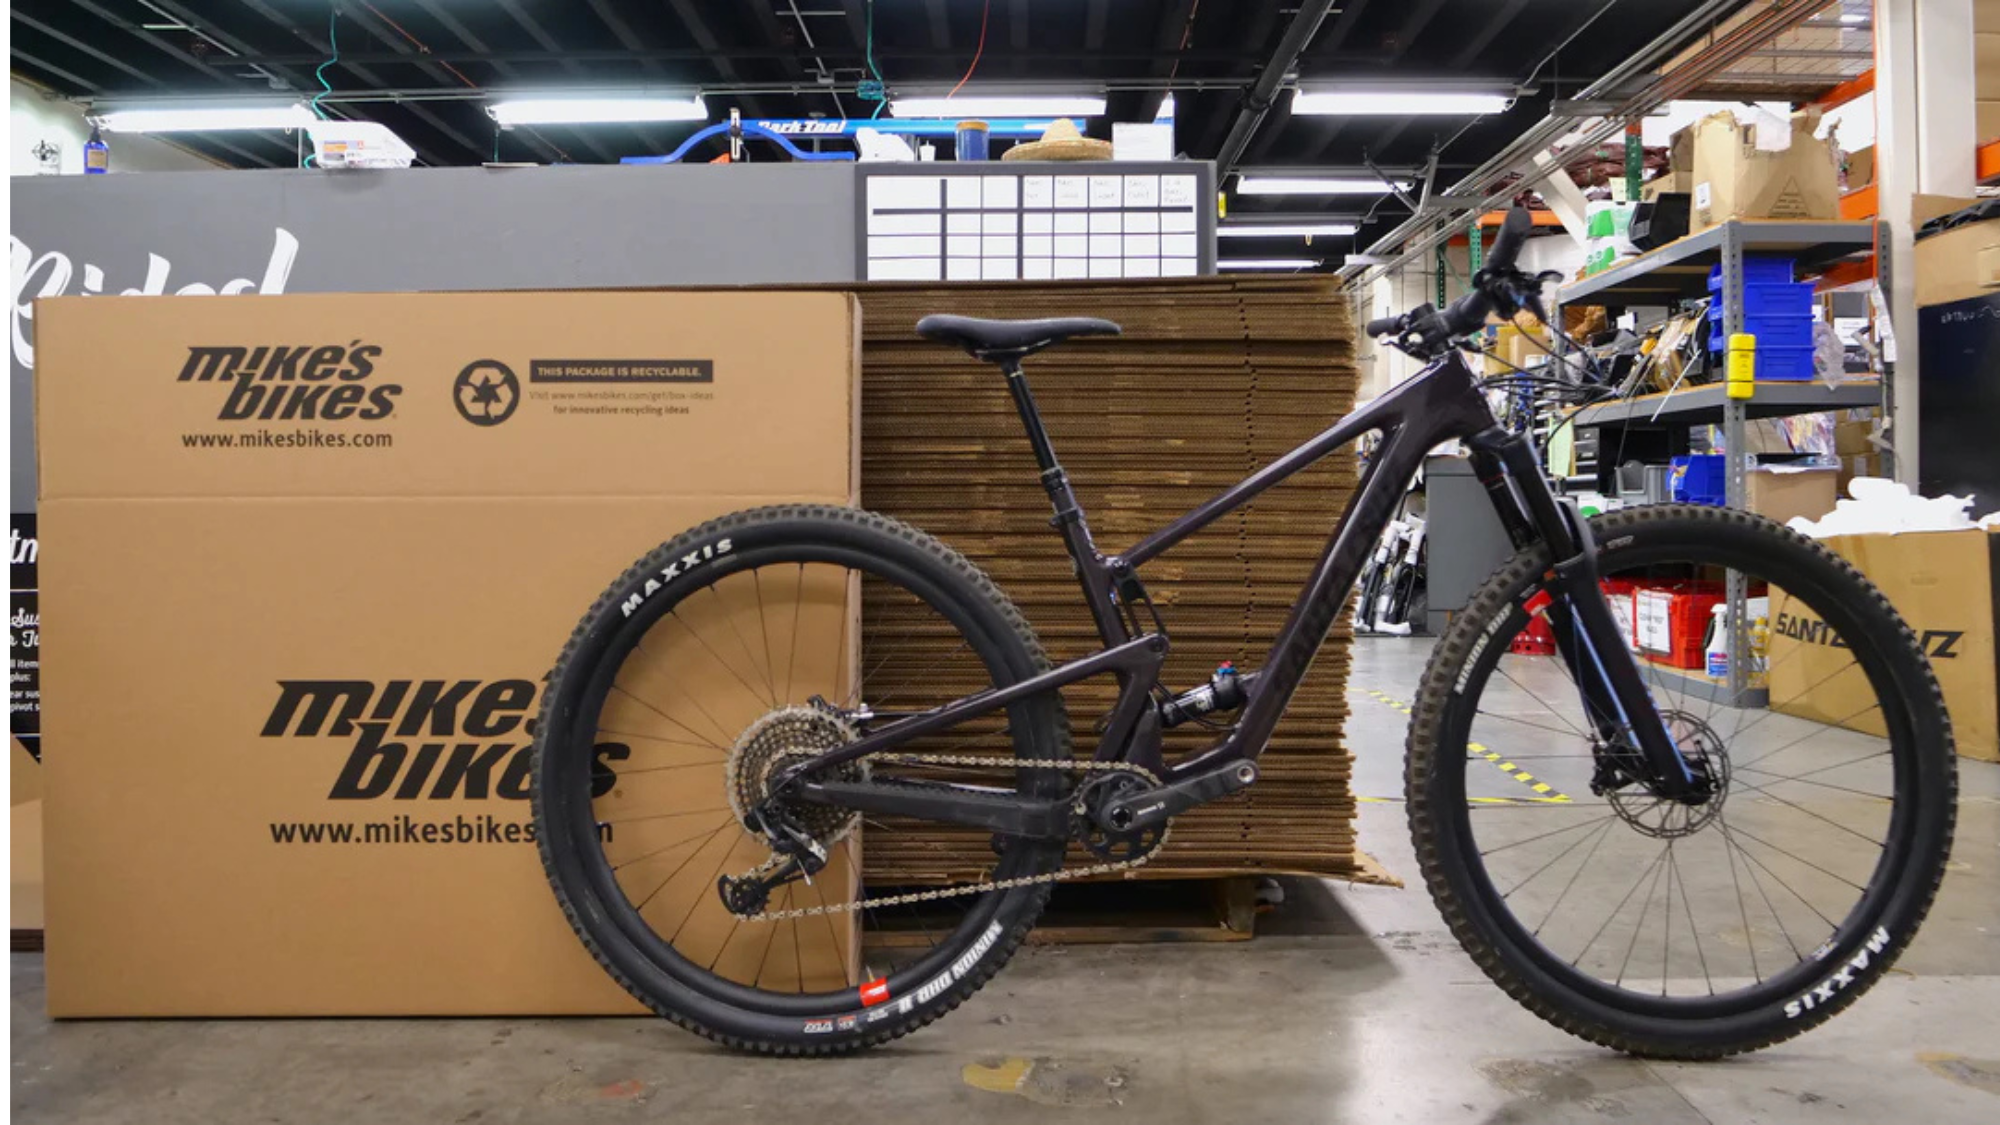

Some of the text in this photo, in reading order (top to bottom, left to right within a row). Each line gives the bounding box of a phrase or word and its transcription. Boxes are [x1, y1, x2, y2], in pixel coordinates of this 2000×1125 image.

[537, 366, 702, 377] THIS PACKAGE IS RECYCLABLE.
[529, 390, 549, 400] Visit
[553, 405, 689, 417] for innovative recycling ideas
[182, 430, 393, 447] www.mikesbikes.com
[621, 538, 732, 618] MAXXIS
[1453, 630, 1490, 695] MINION
[952, 919, 1003, 980] MINION
[1784, 925, 1890, 1018] MAXXIS
